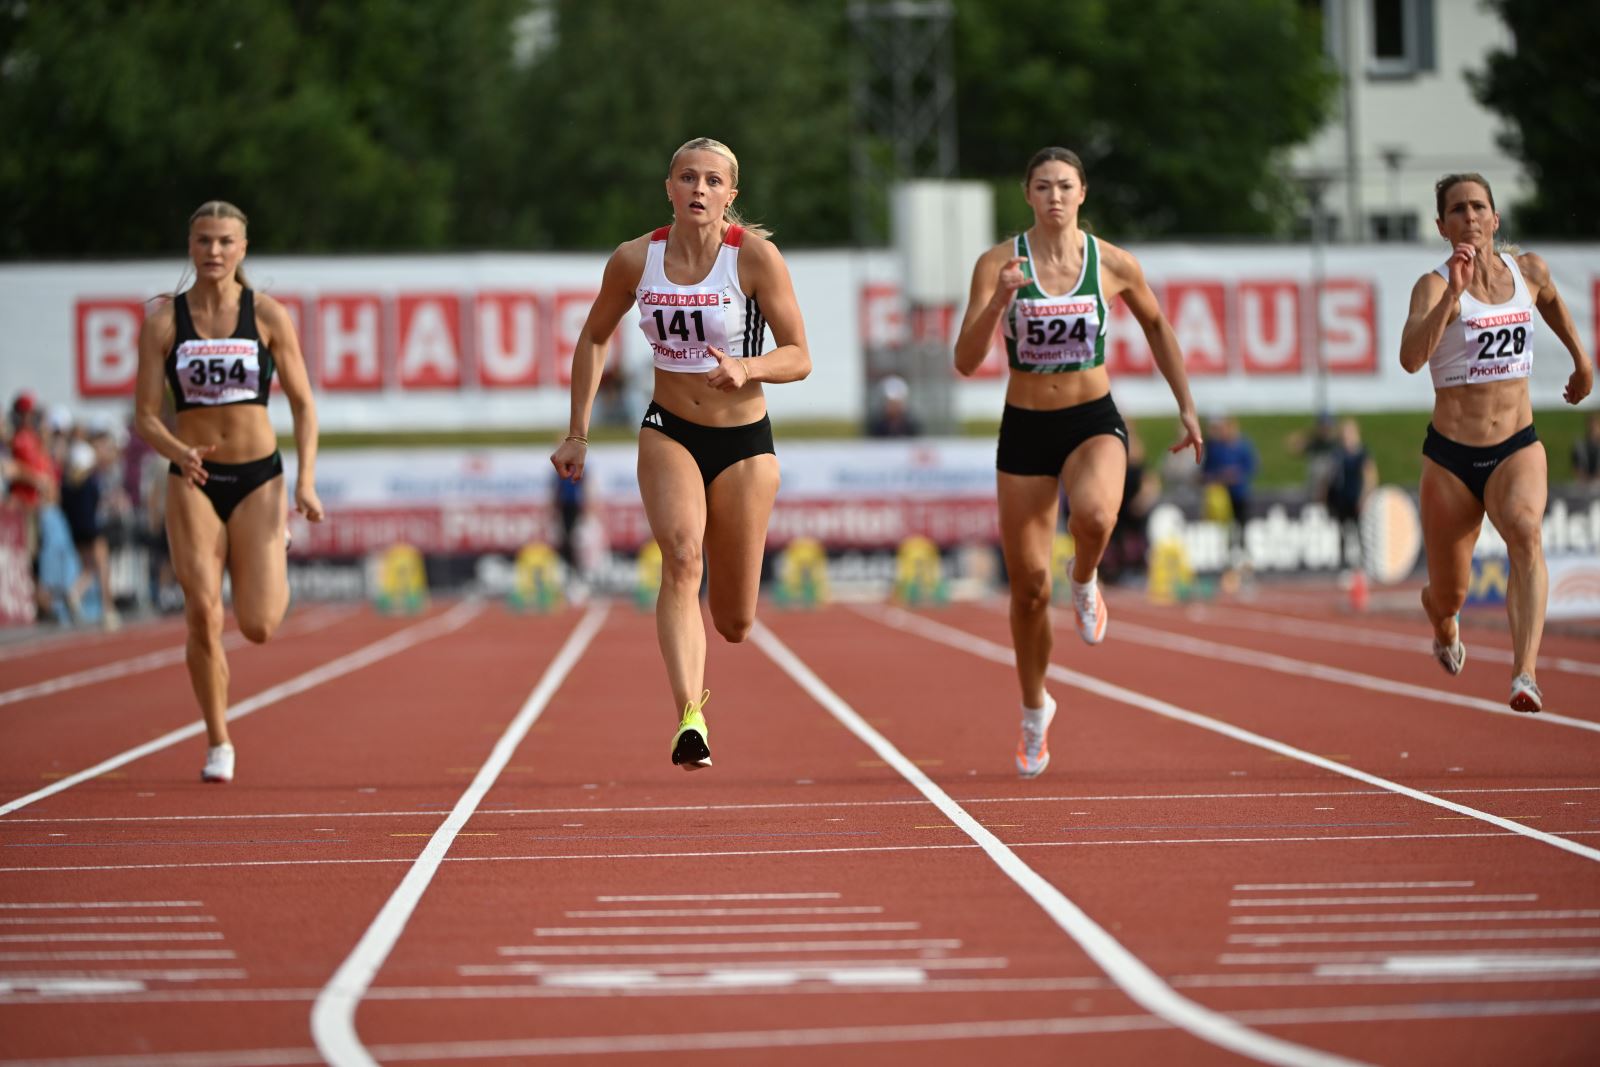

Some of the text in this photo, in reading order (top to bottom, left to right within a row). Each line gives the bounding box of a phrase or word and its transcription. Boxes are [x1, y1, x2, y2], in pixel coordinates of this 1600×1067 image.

[651, 294, 718, 306] BAUHAUS
[653, 309, 705, 341] 141
[866, 284, 1374, 376] BHAUS
[1027, 317, 1086, 346] 524
[1480, 313, 1530, 328] BAUHAUS
[82, 294, 616, 390] BHAU
[651, 343, 724, 359] Prioritet Finas
[1477, 326, 1526, 360] 228
[188, 358, 245, 386] 354
[1470, 362, 1510, 377] Prioritet
